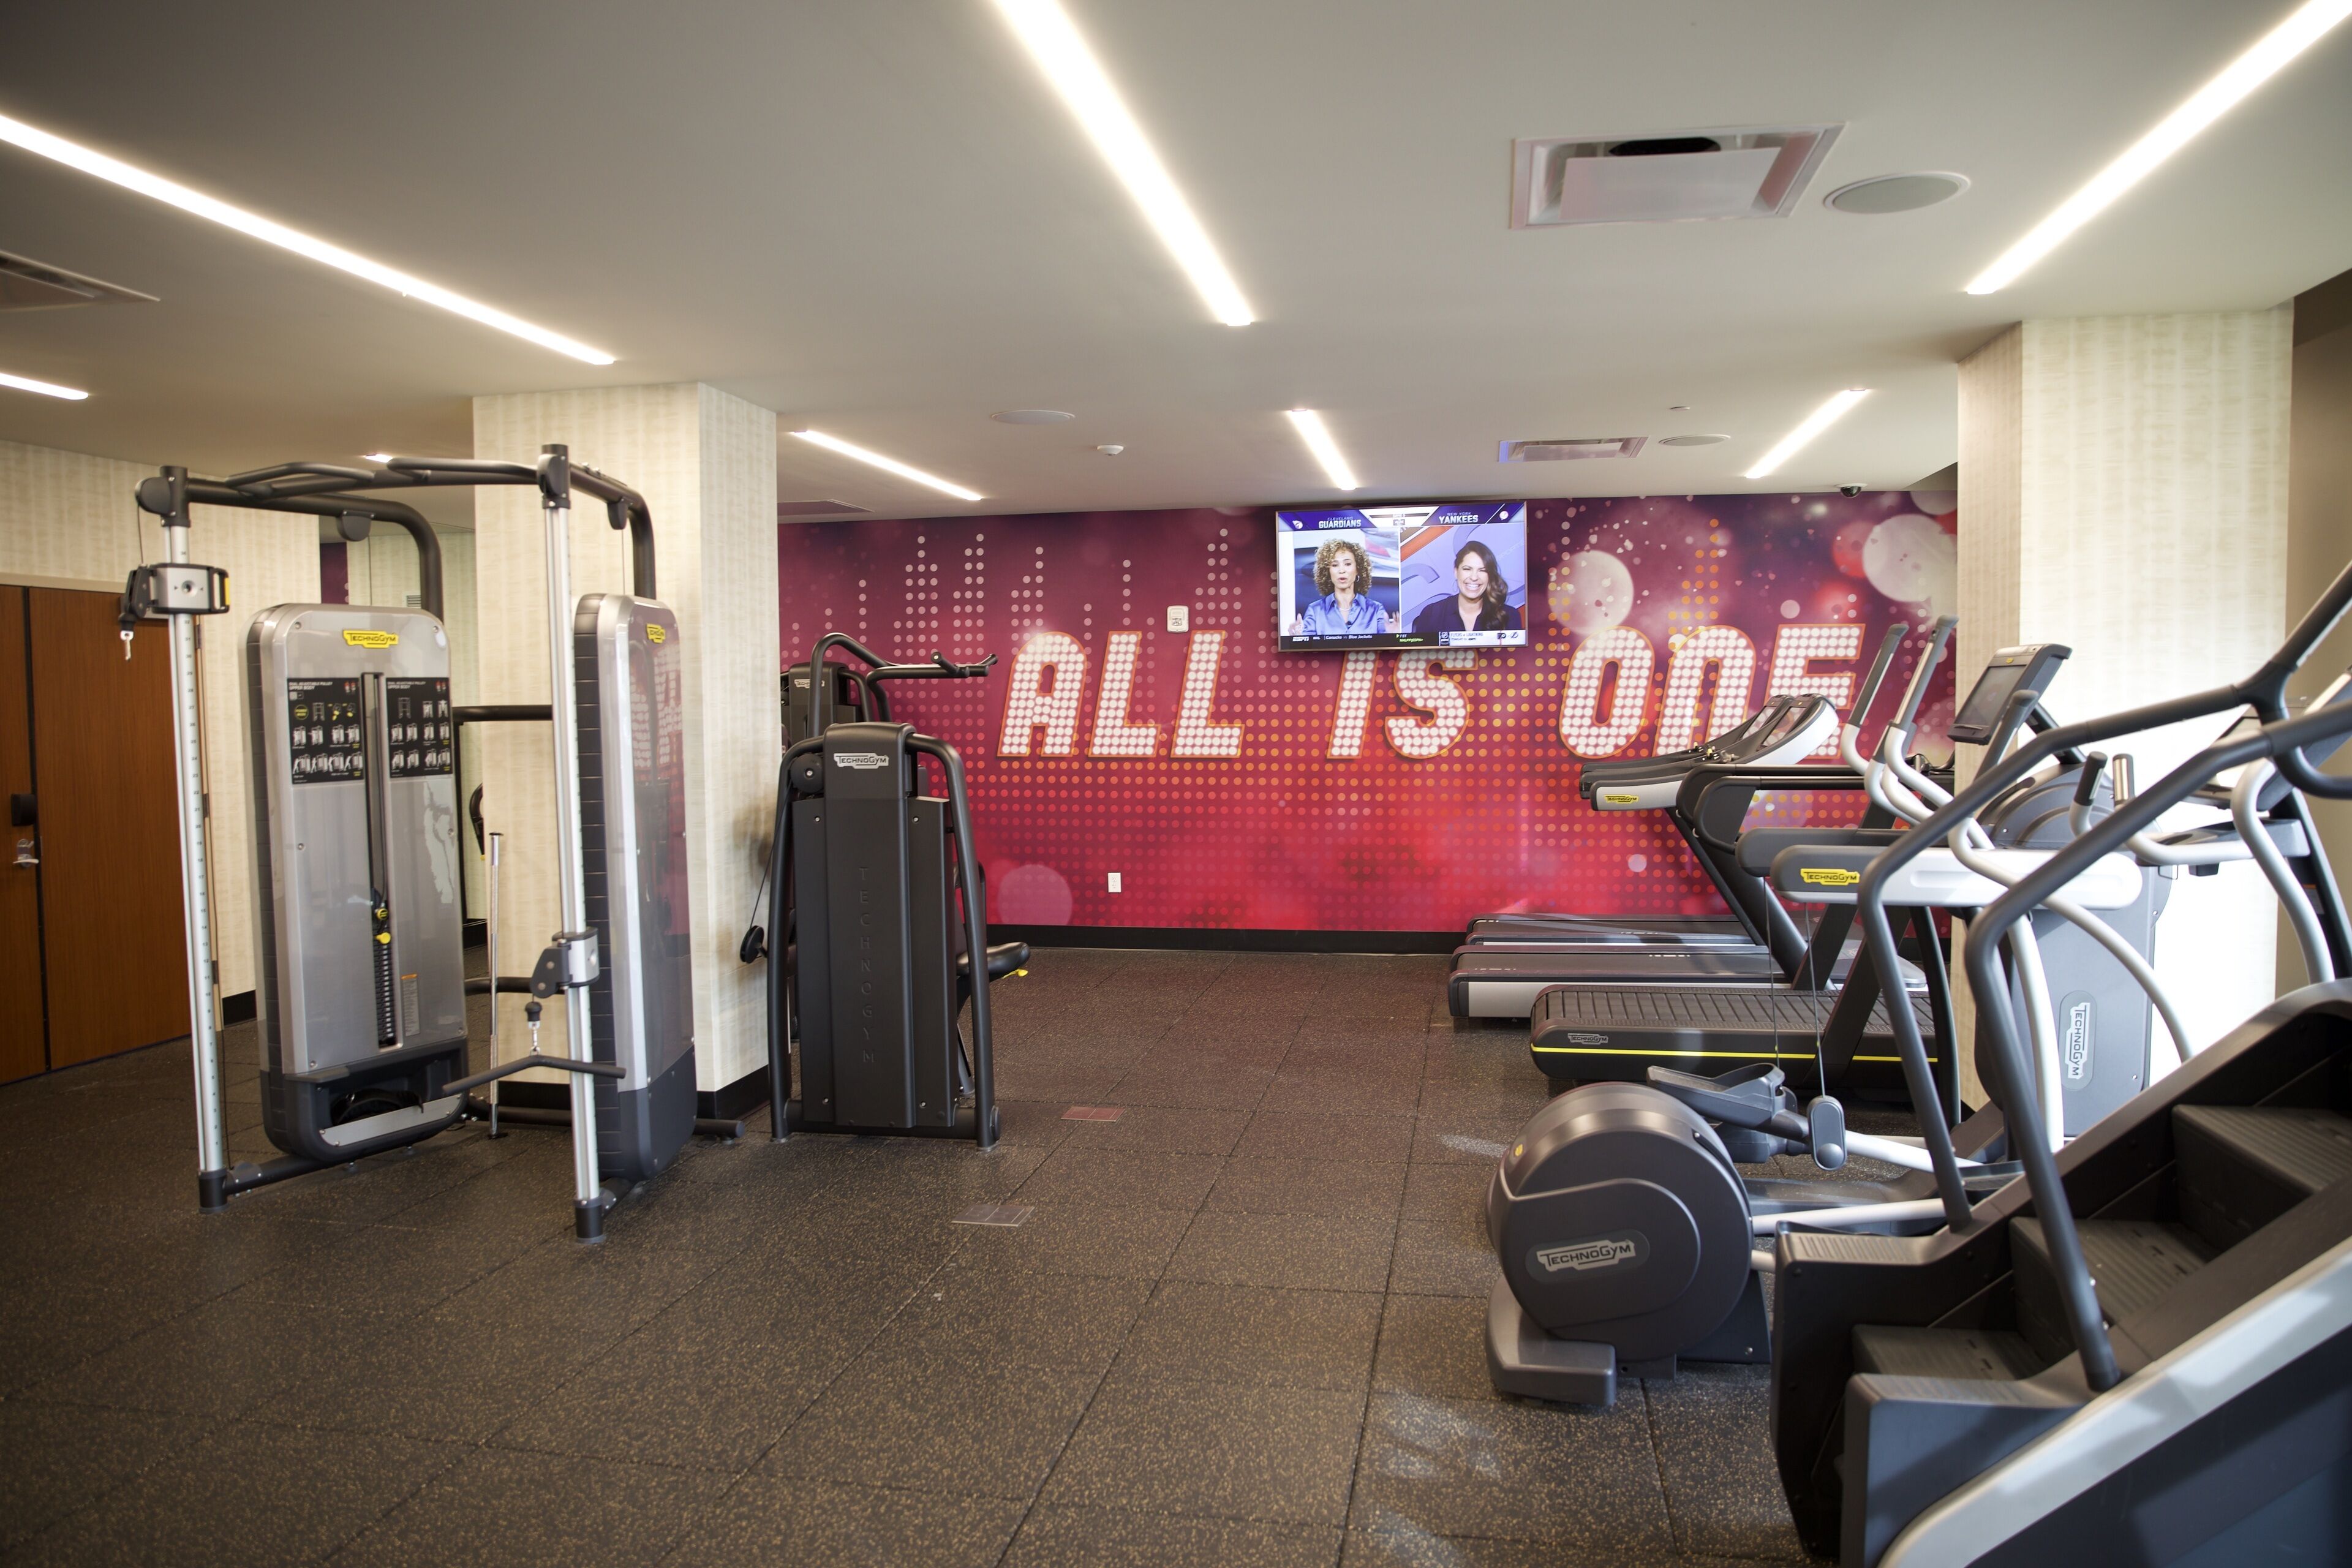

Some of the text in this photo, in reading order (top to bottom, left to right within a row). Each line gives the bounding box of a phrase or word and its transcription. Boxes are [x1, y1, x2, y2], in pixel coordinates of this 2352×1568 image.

[1319, 520, 1362, 529] GUARDIANS
[1439, 515, 1479, 524] YANKEES
[345, 632, 397, 646] TECHNOGYM
[997, 624, 1866, 759] ALL IS ONE
[835, 755, 887, 766] TECHNOGYM
[1803, 872, 1857, 883] TECHNOGYM
[2070, 1005, 2086, 1076] TECHNOGYM
[1540, 1245, 1631, 1266] TECHNOGYM
